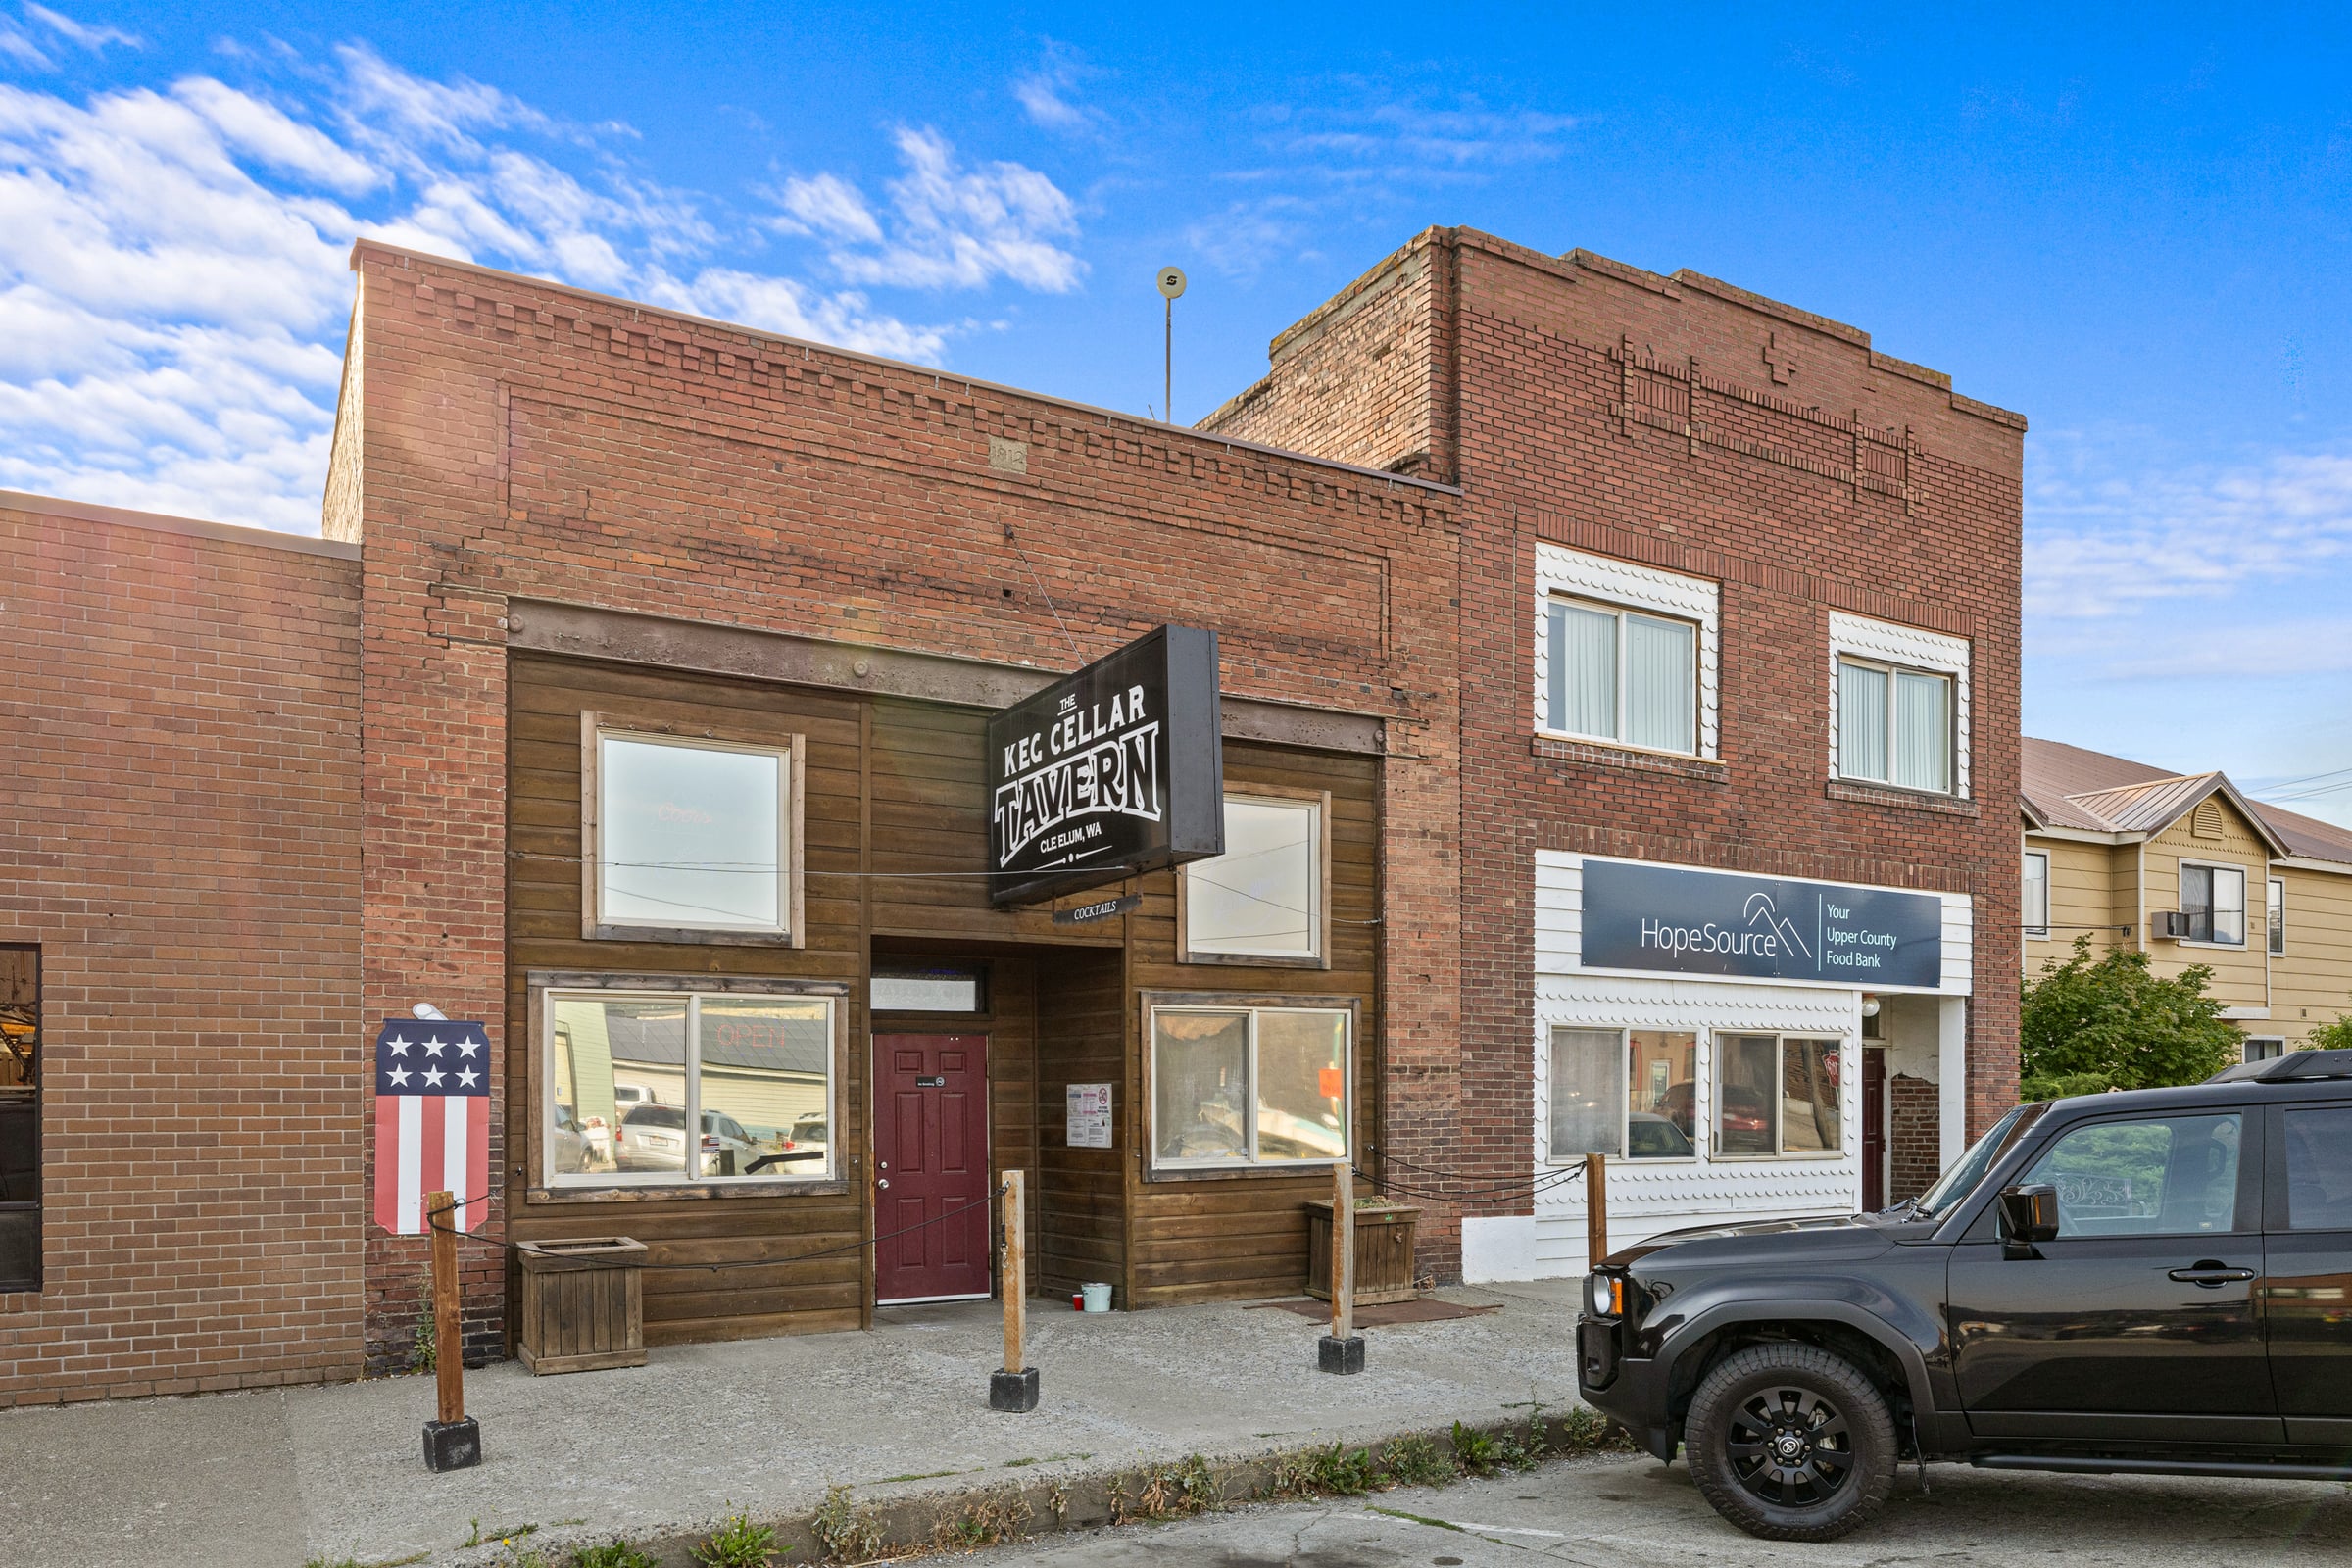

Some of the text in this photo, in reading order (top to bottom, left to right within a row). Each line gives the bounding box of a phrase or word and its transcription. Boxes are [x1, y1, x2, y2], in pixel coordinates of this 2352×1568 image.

[1059, 693, 1076, 710] THE
[1004, 685, 1147, 778] KEG CELLAR
[994, 720, 1162, 869] TAVERN
[1040, 821, 1102, 854] CLE ELUM, WA
[1074, 900, 1117, 920] COCKTAILS
[1827, 904, 1850, 920] Your
[1642, 917, 1777, 958] HopeSource
[1827, 927, 1897, 951] Upper County
[1827, 952, 1881, 969] Food Bank
[716, 1023, 785, 1048] OPEN
